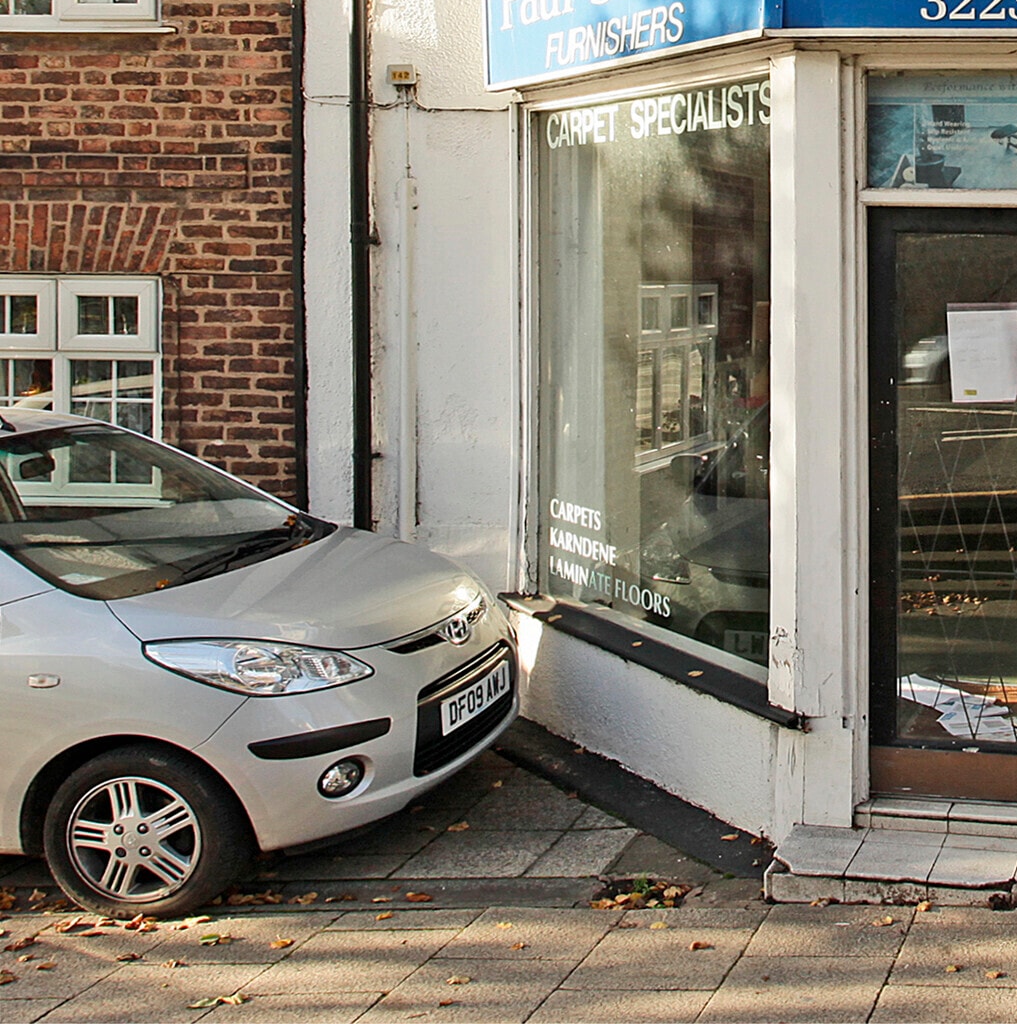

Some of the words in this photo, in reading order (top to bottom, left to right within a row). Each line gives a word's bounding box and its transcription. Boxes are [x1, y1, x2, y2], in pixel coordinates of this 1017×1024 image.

[544, 2, 685, 68] FURNISHERS
[546, 106, 619, 149] CARPET
[630, 80, 770, 139] SPECIALISTS
[550, 498, 601, 531] CARPETS
[550, 527, 617, 566] KARNDENE
[550, 556, 611, 596] LAMINATE
[614, 580, 671, 618] FLOORS
[449, 685, 484, 726] DF09
[486, 667, 506, 702] AWJ
